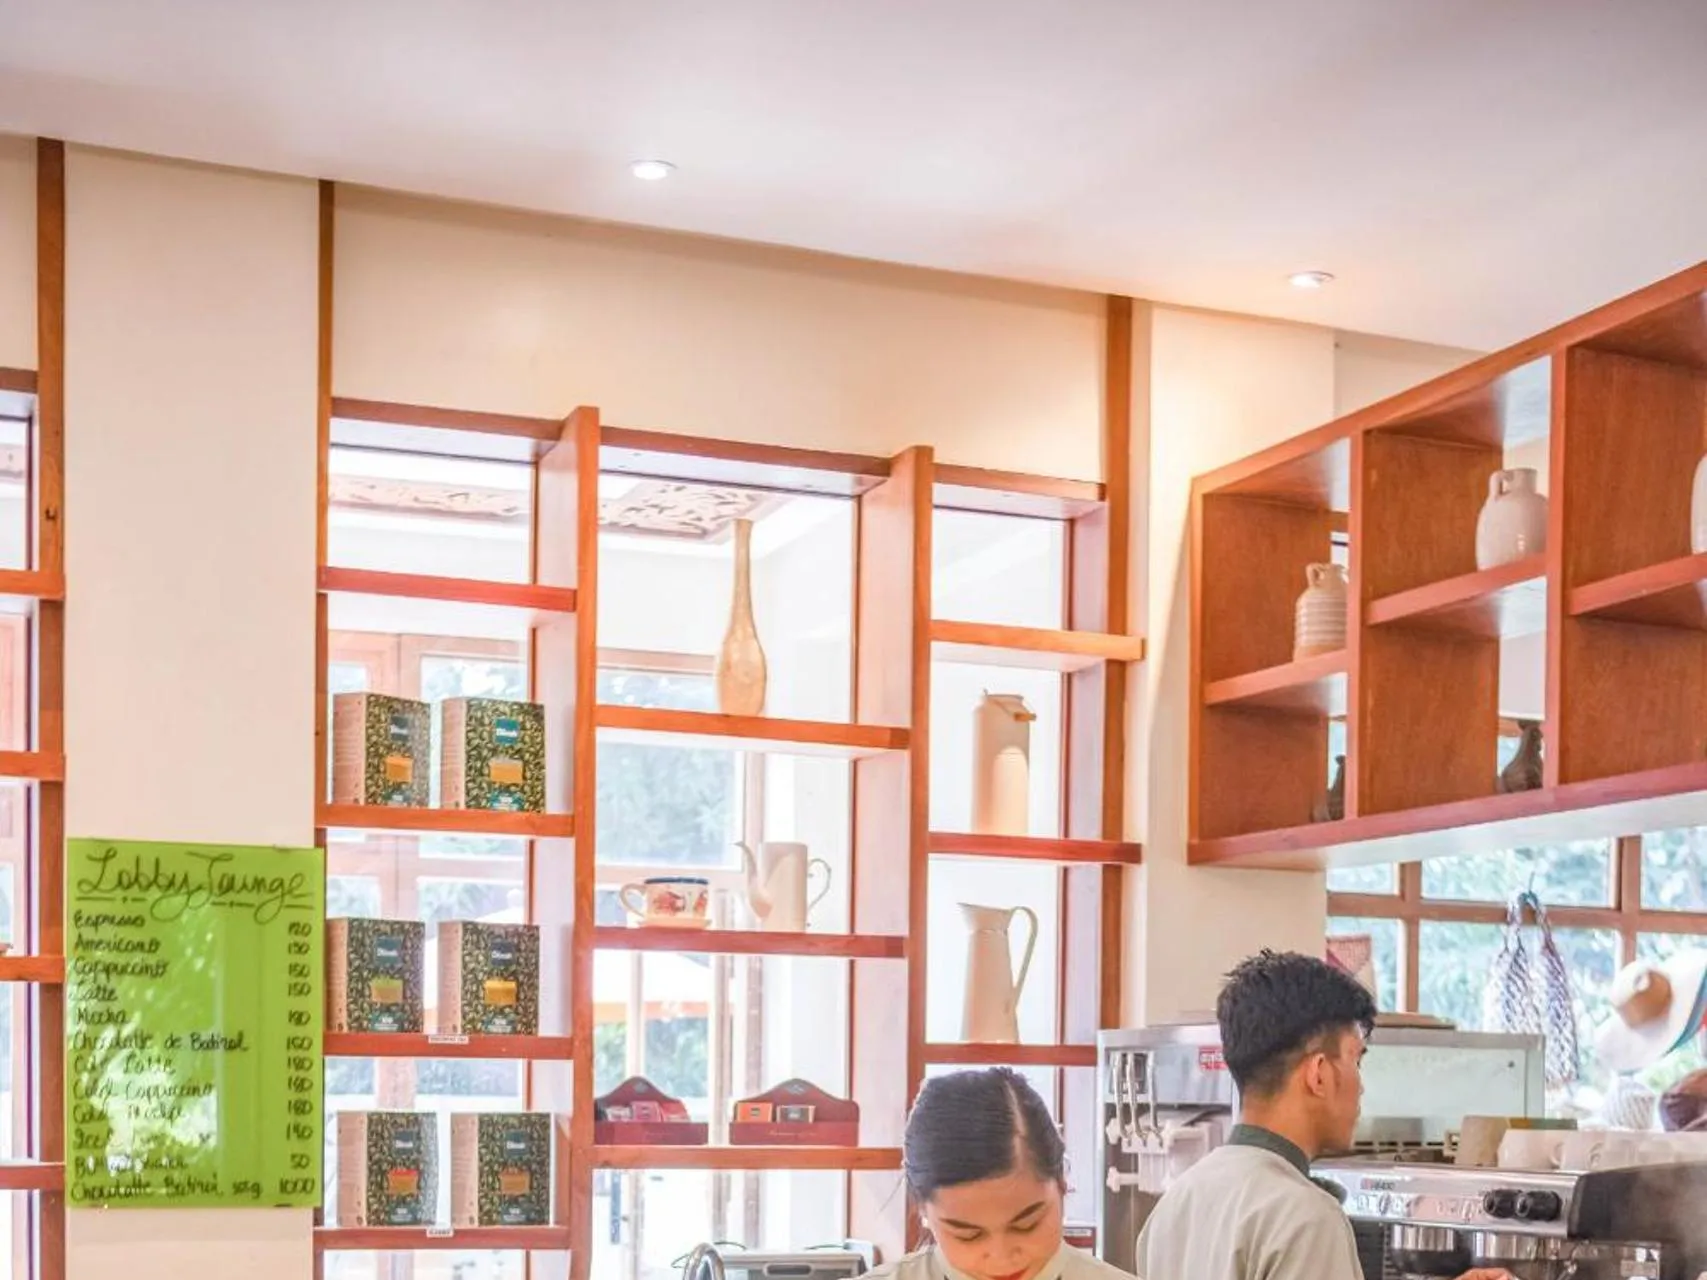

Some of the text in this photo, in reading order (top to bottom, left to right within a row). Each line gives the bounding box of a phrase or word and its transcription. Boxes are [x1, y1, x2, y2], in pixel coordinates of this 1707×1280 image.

[76, 847, 194, 923] Lobby
[74, 909, 145, 934] Espresso
[74, 933, 161, 954] Americano
[164, 1032, 182, 1049] de
